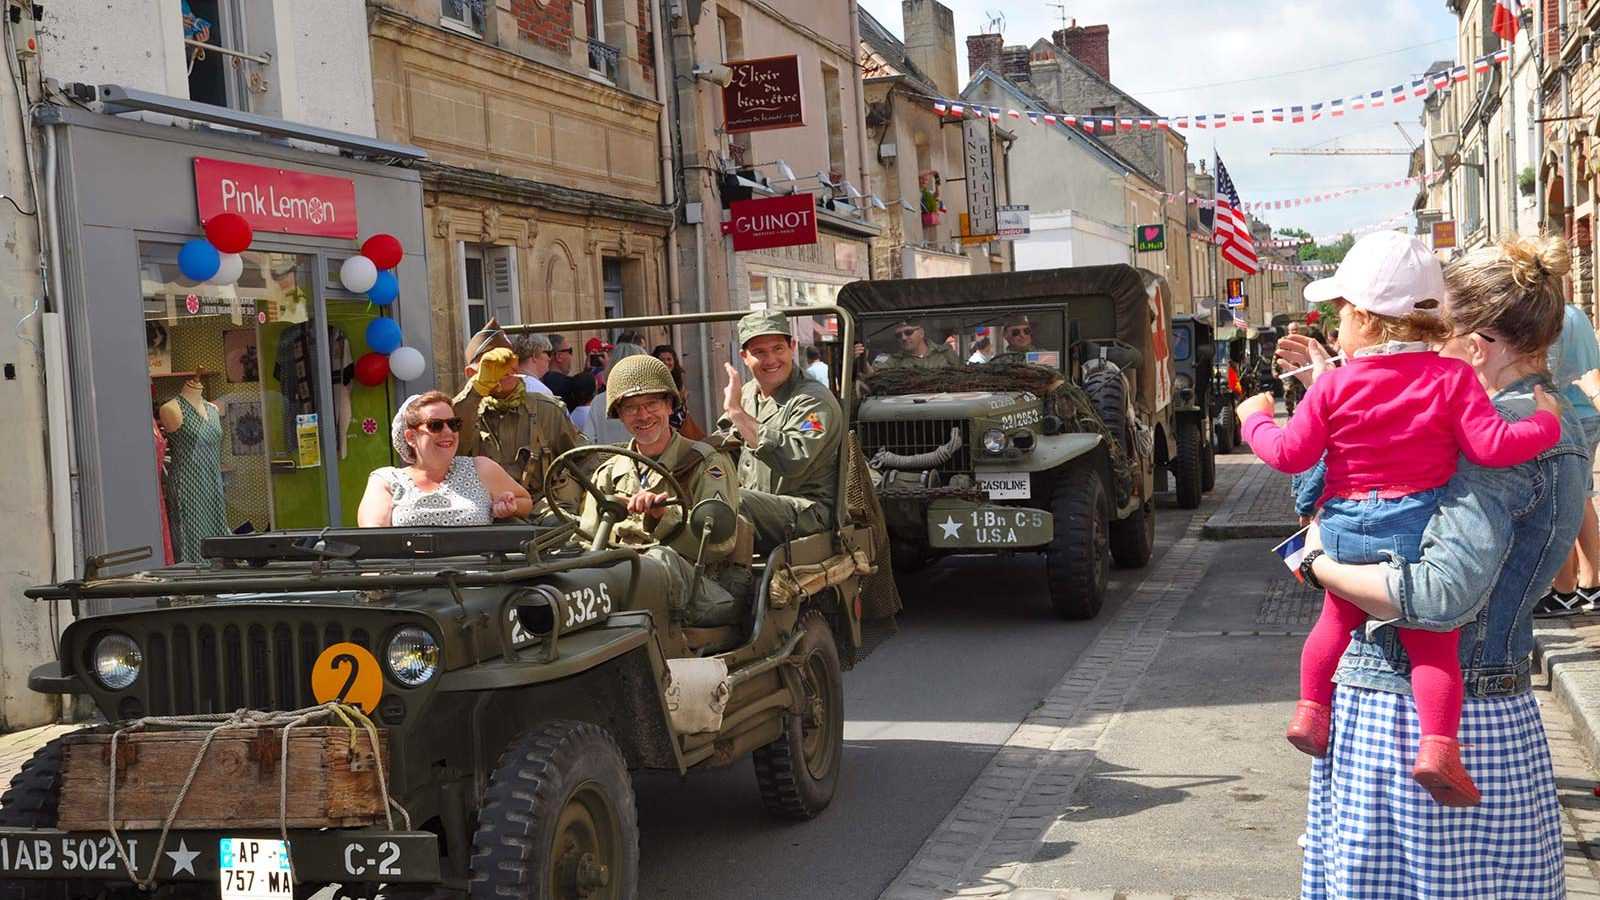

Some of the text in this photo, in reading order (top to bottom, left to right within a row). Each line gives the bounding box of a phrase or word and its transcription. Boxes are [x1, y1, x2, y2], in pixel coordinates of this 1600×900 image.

[764, 83, 781, 92] du
[967, 126, 981, 229] INSTITUT
[221, 178, 336, 225] Pink Lemon
[735, 210, 811, 233] GUINOT
[980, 480, 1027, 491] GASOLINE
[1015, 511, 1043, 528] C-5
[976, 527, 1018, 543] U.S.A
[330, 653, 363, 712] 2
[0, 838, 54, 871] 1AB
[344, 841, 402, 875] C-2
